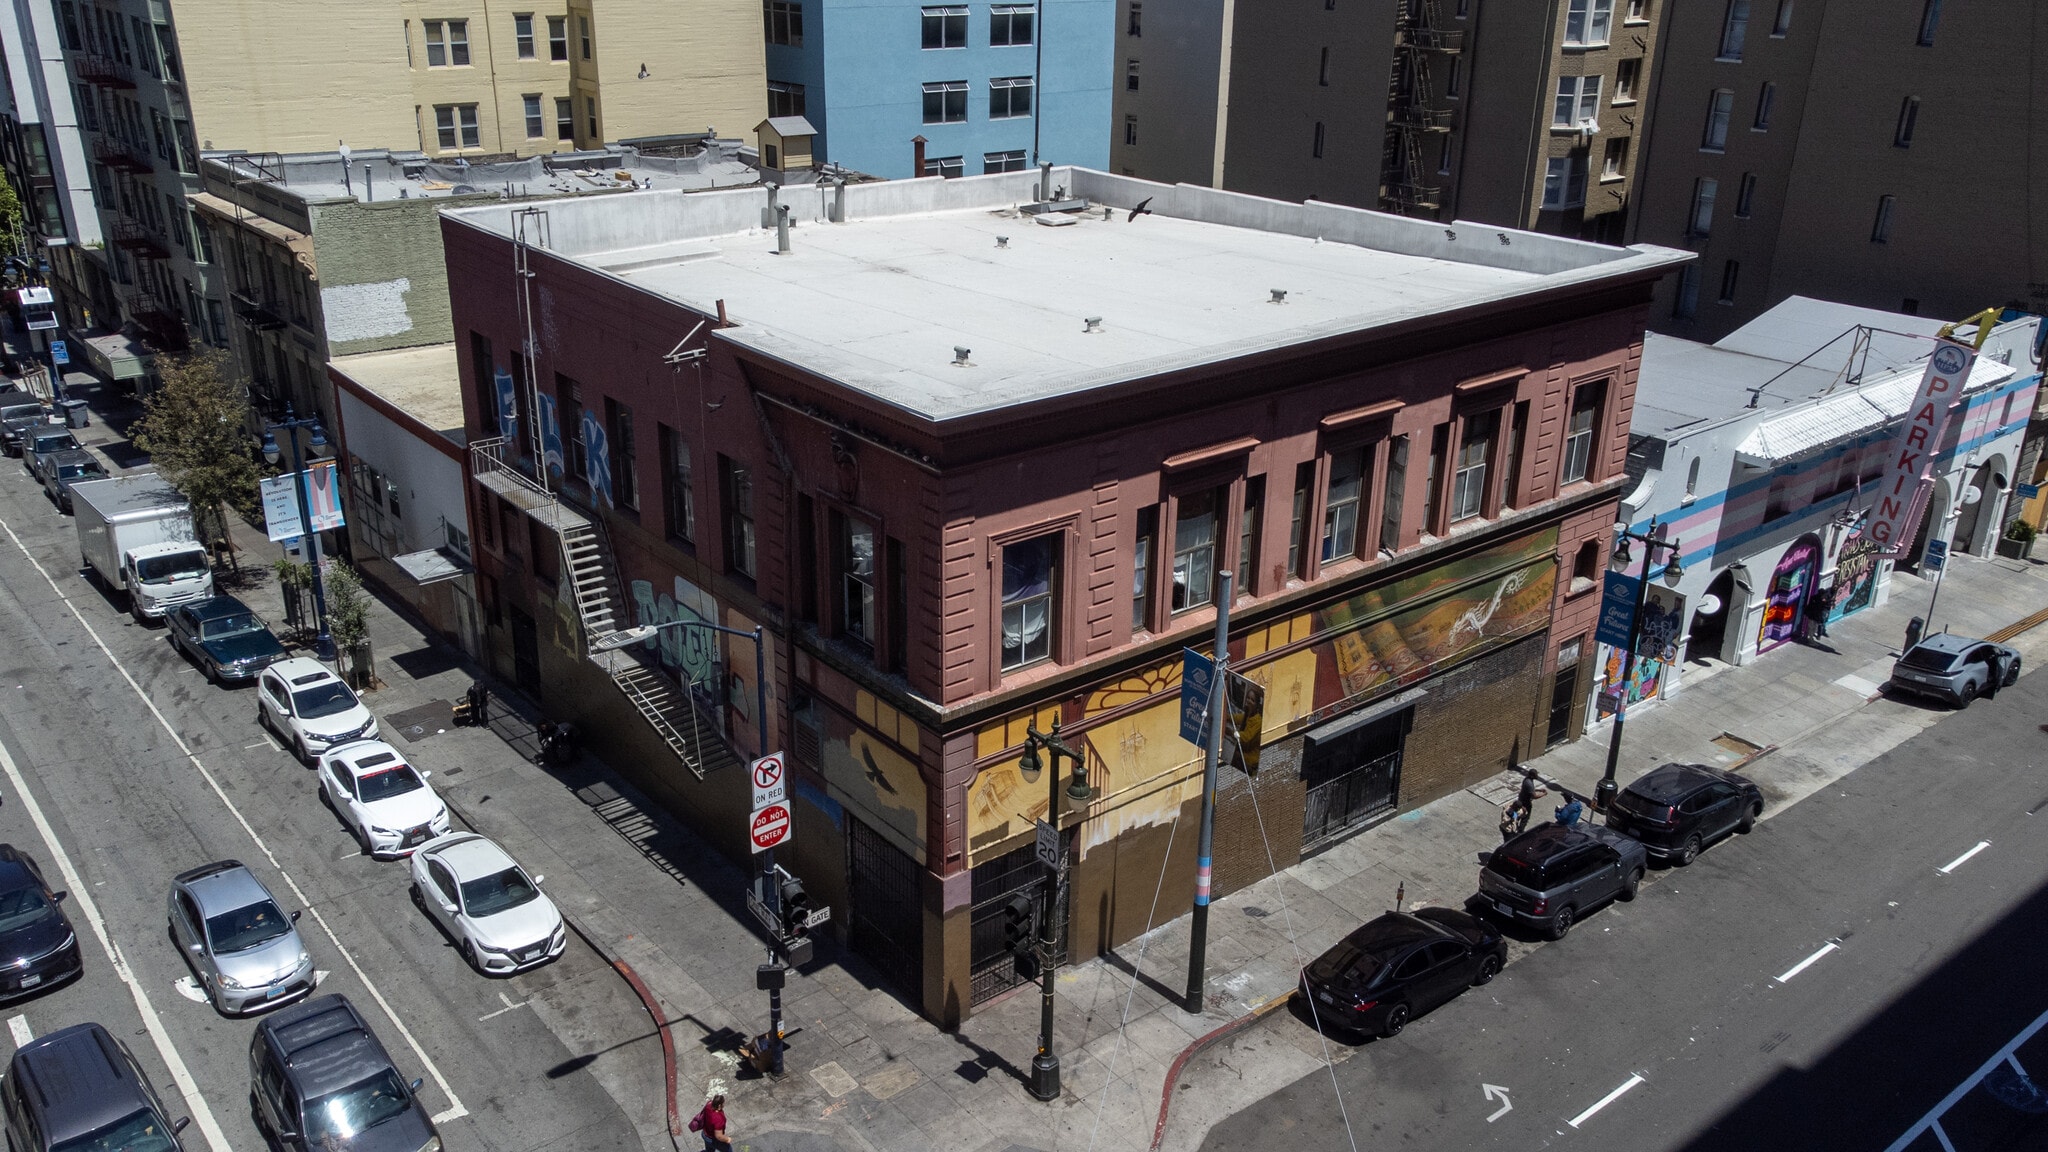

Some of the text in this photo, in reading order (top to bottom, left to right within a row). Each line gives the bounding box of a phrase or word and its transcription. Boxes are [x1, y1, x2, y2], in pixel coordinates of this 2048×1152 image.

[1872, 375, 1948, 544] PARKING
[265, 487, 292, 496] REVOLUTION
[268, 516, 299, 526] TRANSGENDER
[1608, 606, 1629, 620] Great
[1603, 615, 1629, 632] Futures
[756, 787, 782, 804] ON RED
[756, 809, 784, 827] DO NOT
[760, 828, 782, 843] ENTER
[1039, 823, 1058, 841] SPEED
[1040, 832, 1055, 848] LIMIT
[1039, 841, 1056, 863] 20
[811, 910, 829, 924] GATE
